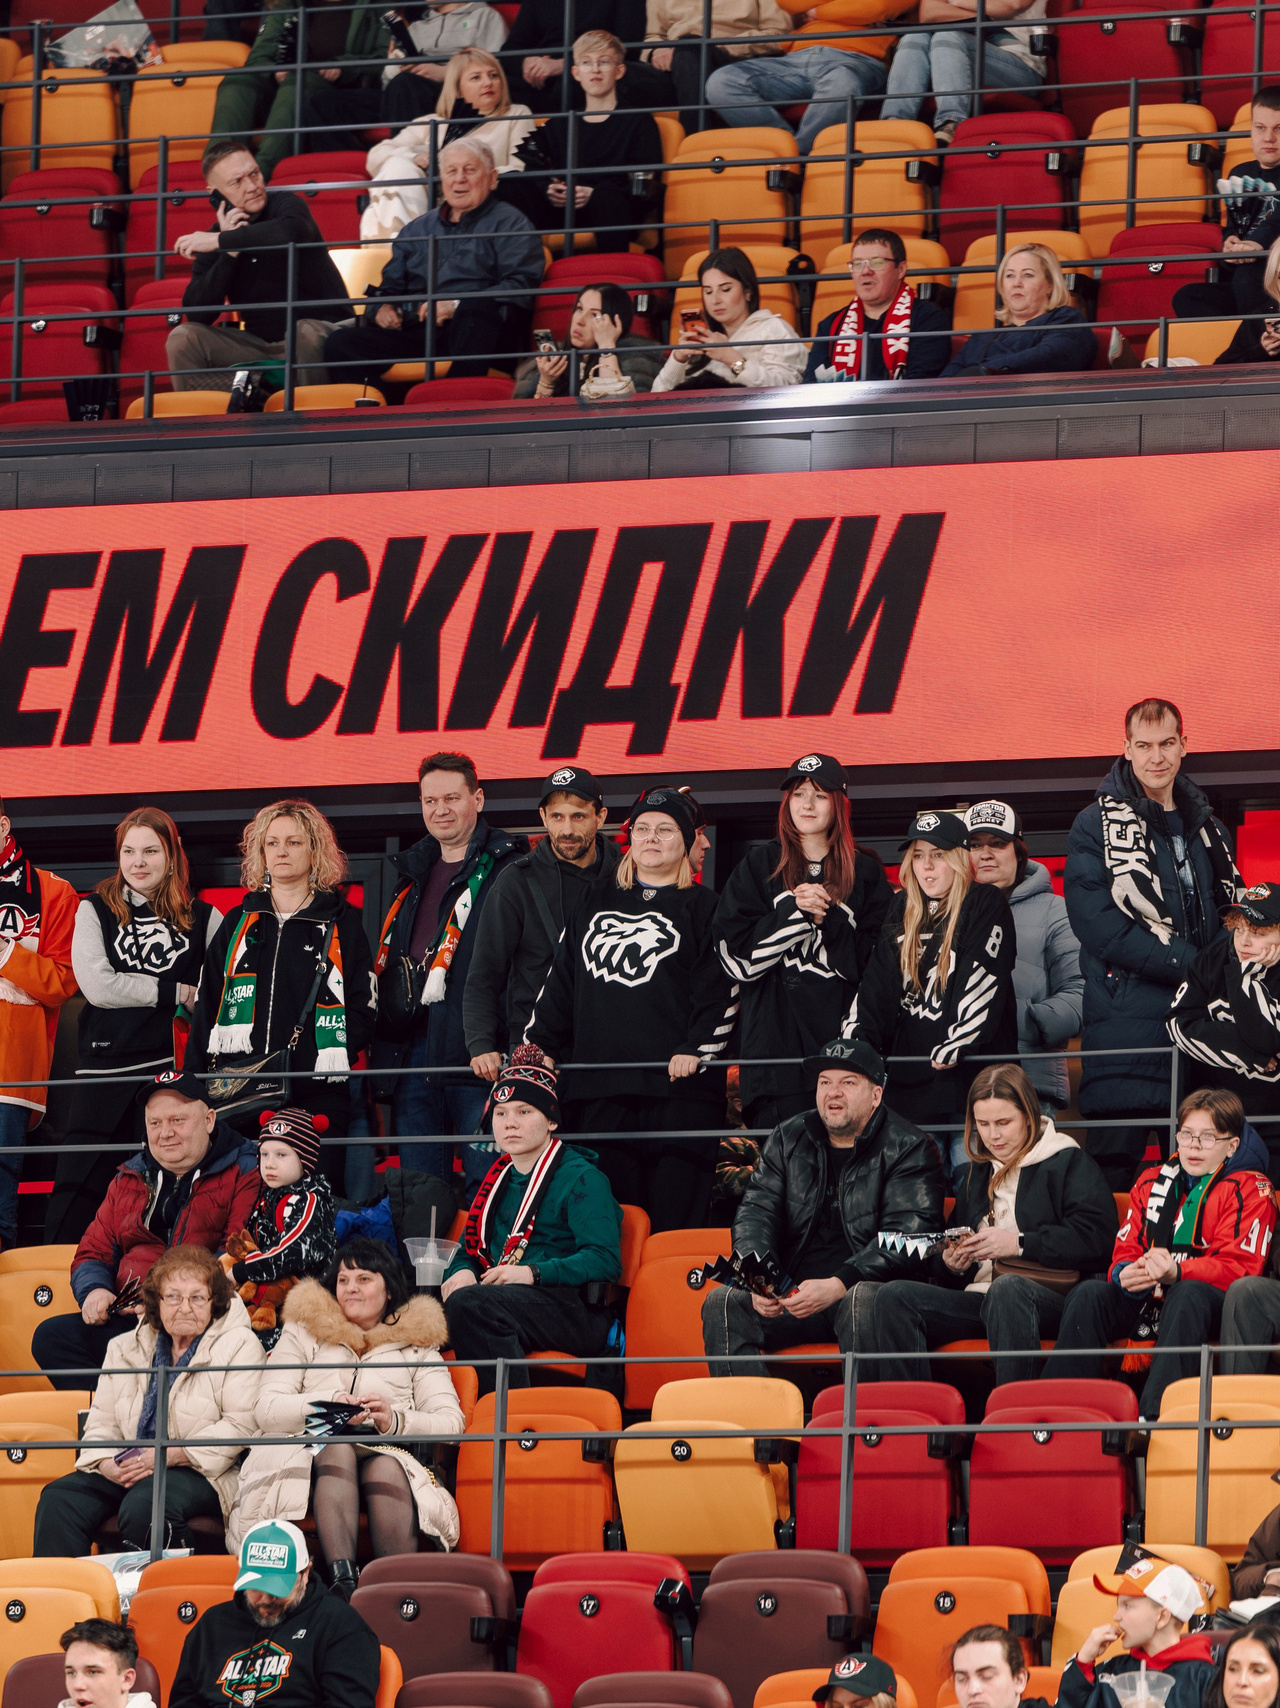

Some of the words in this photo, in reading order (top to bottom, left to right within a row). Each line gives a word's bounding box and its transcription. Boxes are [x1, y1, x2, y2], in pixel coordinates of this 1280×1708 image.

[251, 512, 946, 760] СКИДКИ
[972, 818, 1002, 826] HOCKEY
[316, 1014, 337, 1028] ALL
[690, 1274, 702, 1283] 21
[37, 1291, 49, 1299] 25
[674, 1446, 687, 1455] 20
[250, 1544, 265, 1557] ALL
[265, 1546, 286, 1559] STAR
[402, 1603, 414, 1613] 18
[582, 1600, 594, 1610] 17
[759, 1599, 771, 1609] 16
[8, 1605, 21, 1615] 20
[180, 1607, 192, 1616] 19
[253, 1655, 291, 1678] STAR
